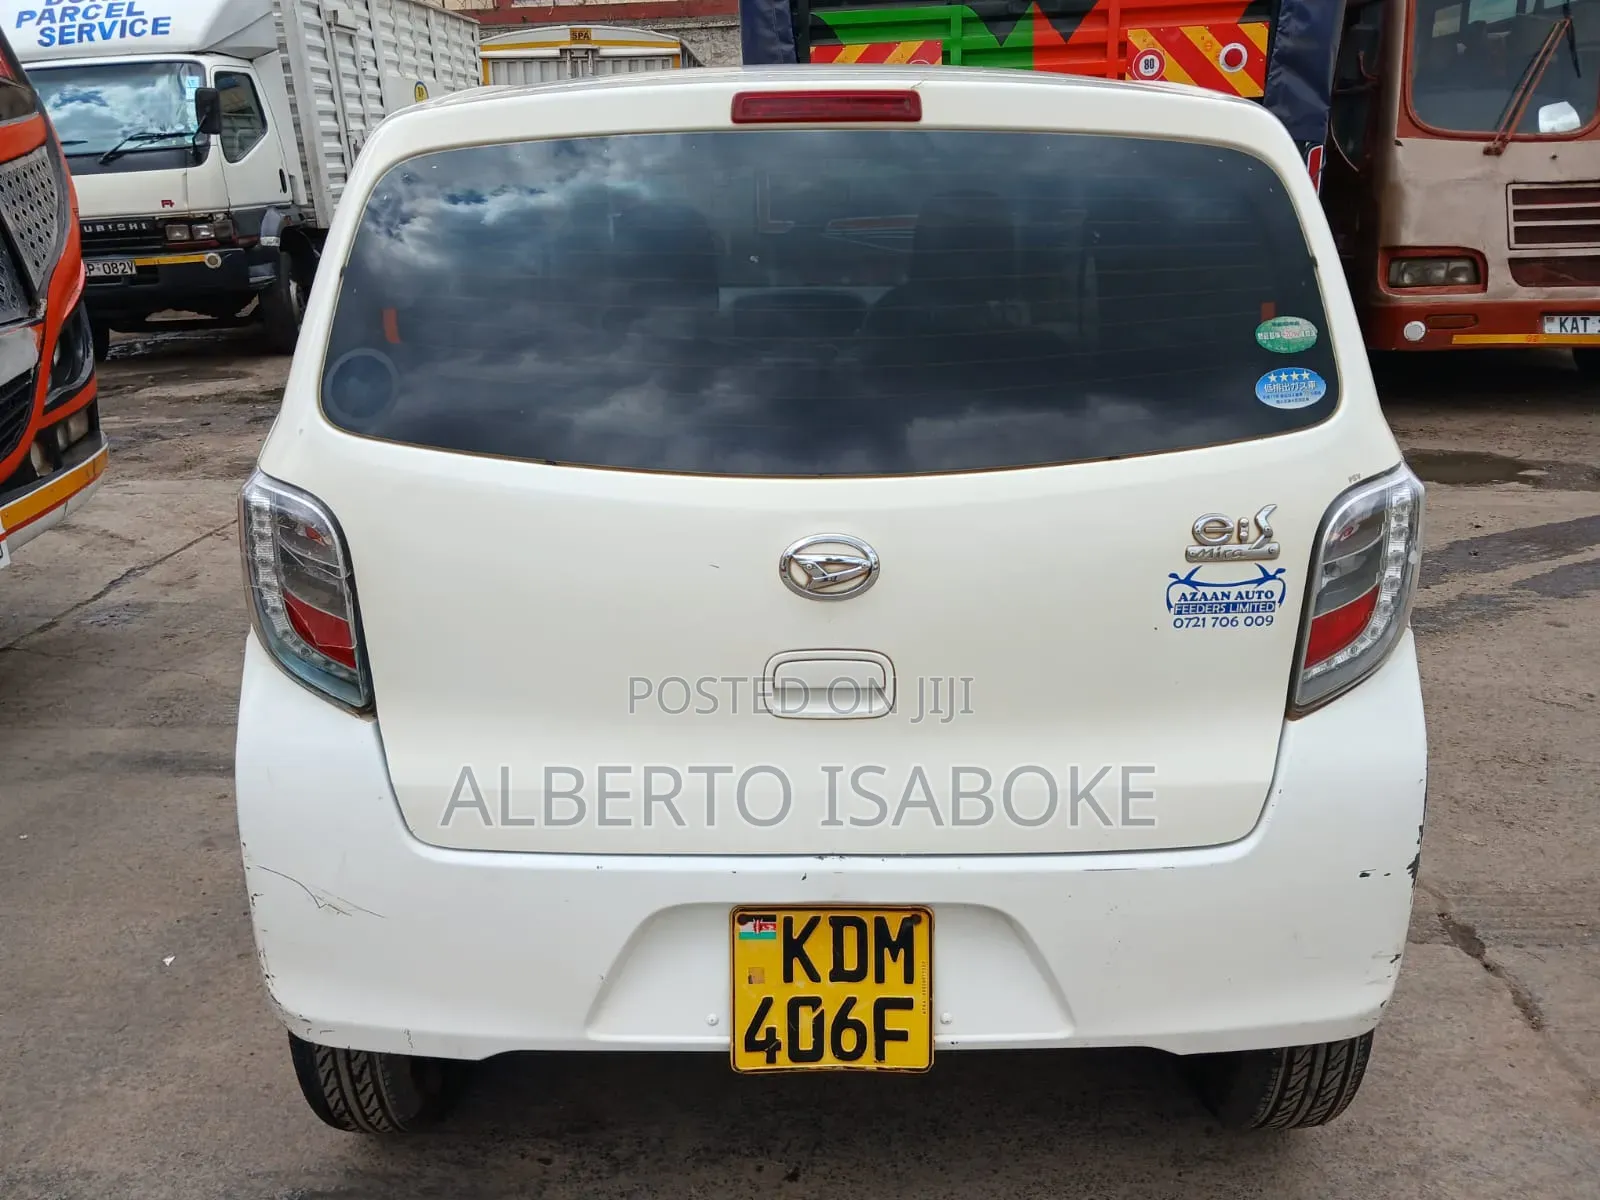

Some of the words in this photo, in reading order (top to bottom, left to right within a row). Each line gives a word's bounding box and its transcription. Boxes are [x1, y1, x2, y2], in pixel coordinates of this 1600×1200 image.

[15, 1, 145, 28] PARCEL
[37, 16, 171, 47] SERVICE
[1144, 58, 1155, 70] 80
[84, 223, 147, 232] UBISHI
[1559, 316, 1590, 333] KAT
[1178, 591, 1231, 602] AZAAN
[1234, 590, 1275, 601] AUTO
[1175, 603, 1227, 615] FEEDERS
[1229, 602, 1275, 613] LIMITED
[1173, 616, 1206, 629] 0721
[1211, 616, 1239, 628] 706
[1244, 615, 1274, 627] 009
[782, 915, 915, 984] KDM
[744, 996, 914, 1064] 406F
